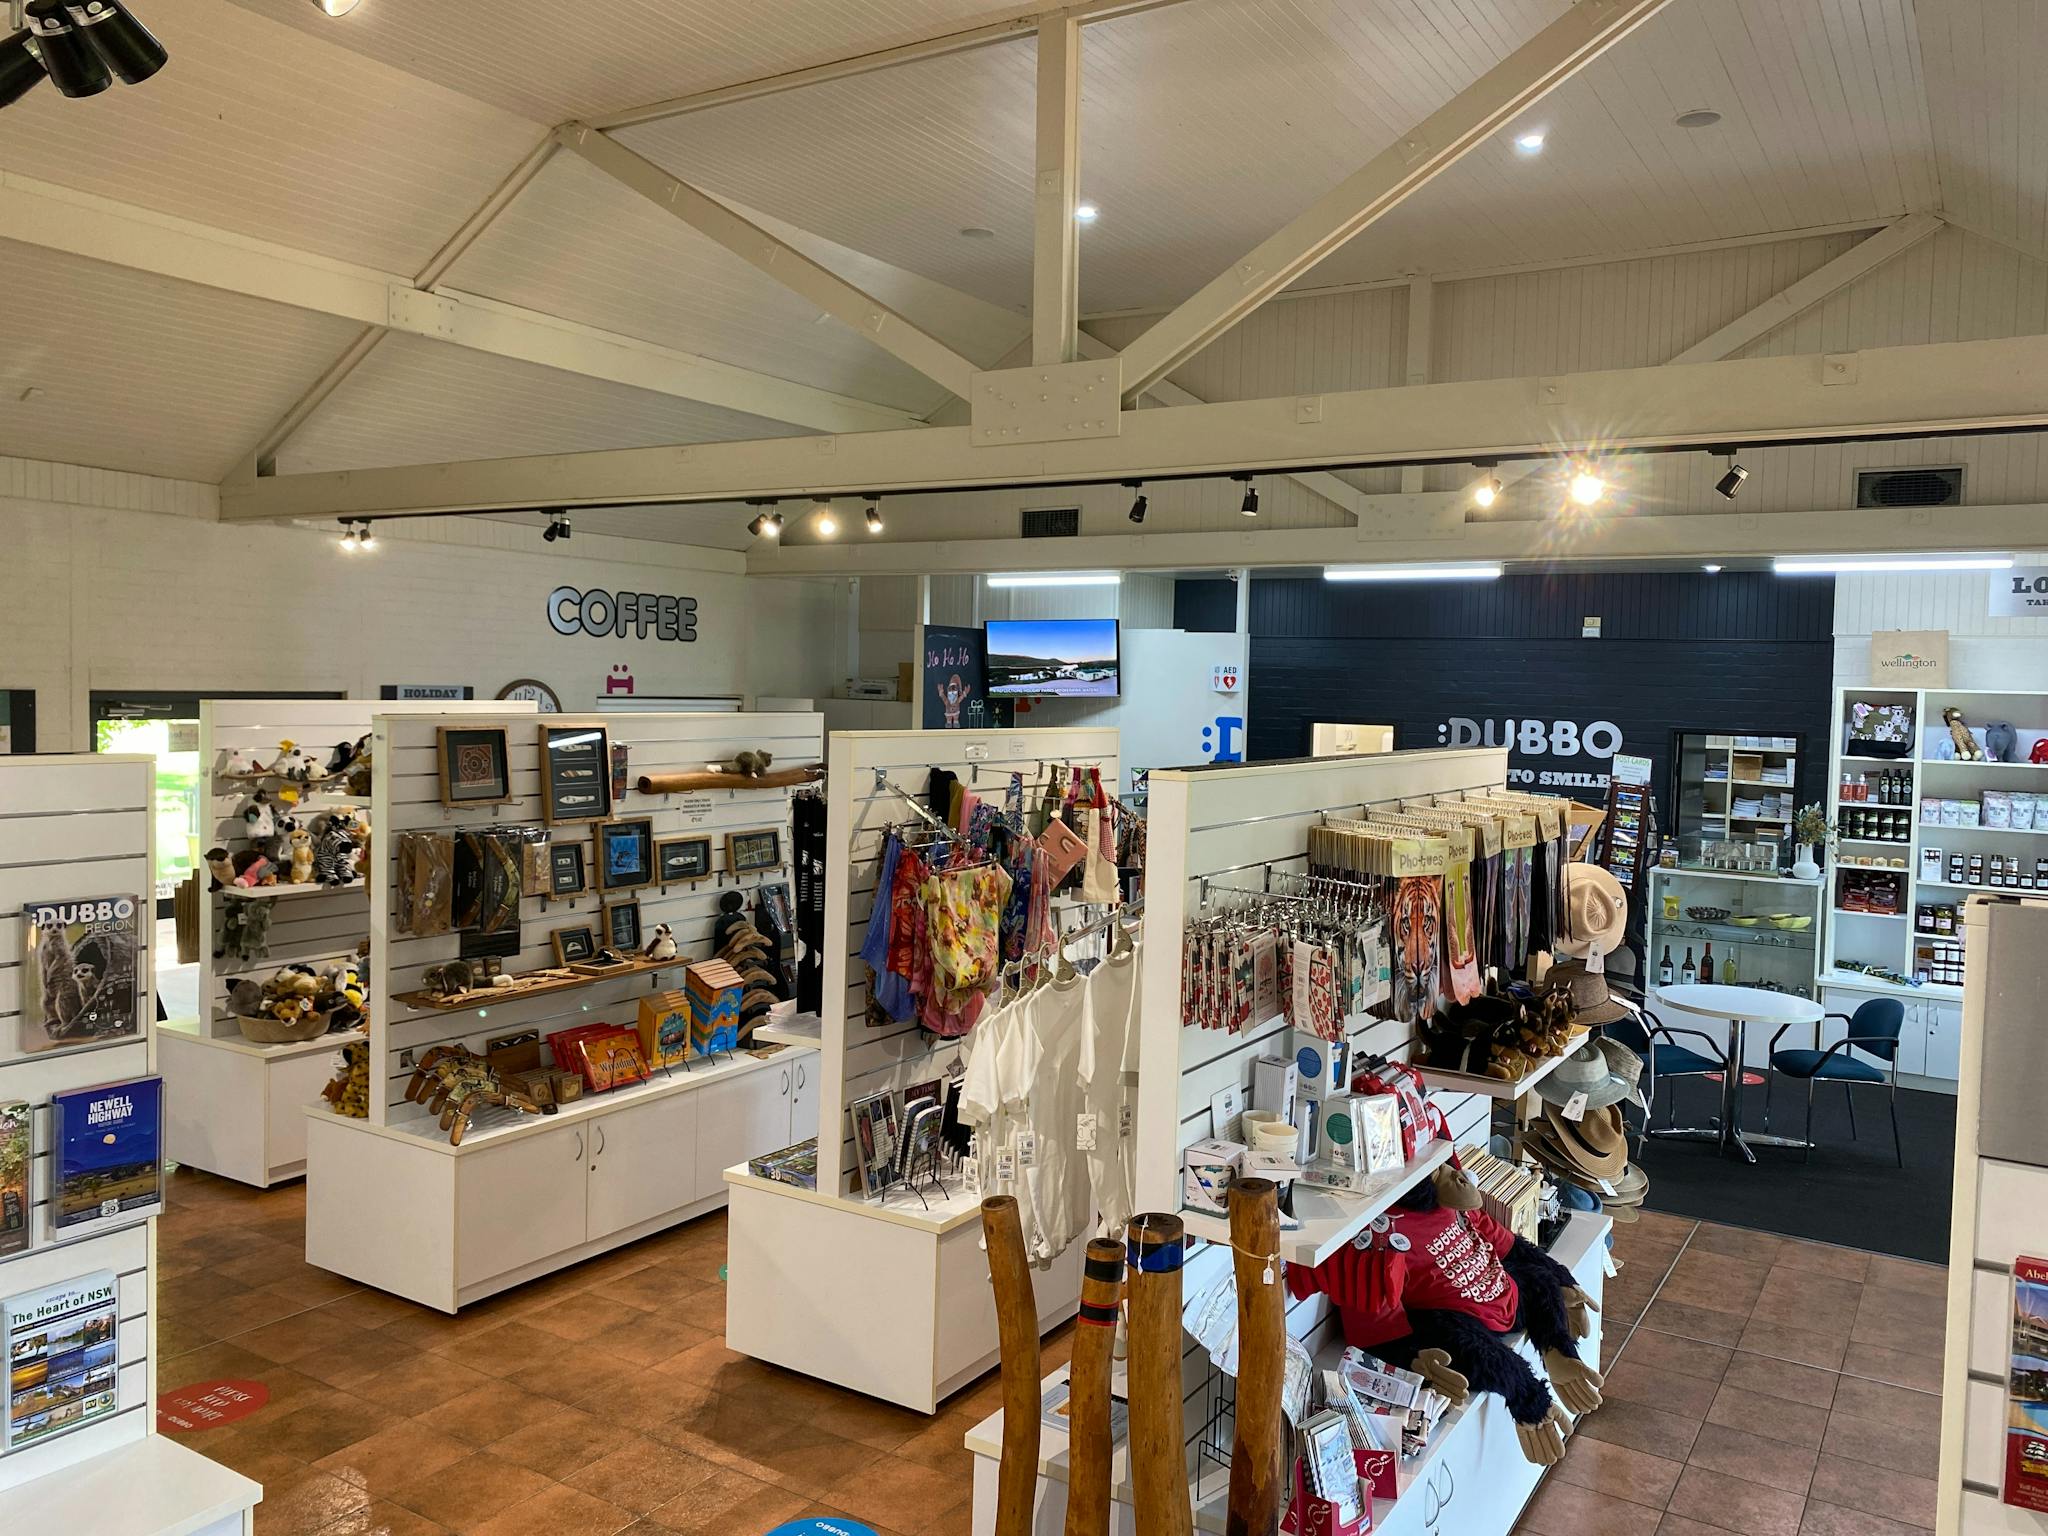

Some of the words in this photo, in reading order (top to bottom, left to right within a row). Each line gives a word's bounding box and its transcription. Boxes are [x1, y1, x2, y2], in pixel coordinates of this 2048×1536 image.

[547, 586, 697, 642] COFFEE
[927, 650, 939, 668] Ho
[943, 647, 955, 668] Ho
[957, 647, 969, 667] Ho
[1881, 657, 1937, 669] wellington
[1223, 666, 1237, 674] AED
[403, 687, 458, 700] HOLIDAY
[1616, 755, 1630, 763] POST
[1632, 758, 1650, 767] CARDS
[1509, 768, 1535, 783] TO
[1539, 772, 1611, 788] SMILE
[84, 919, 134, 934] REGION
[89, 1096, 132, 1113] NEWELL
[87, 1105, 133, 1125] HIGHWAY
[105, 1206, 115, 1214] 39
[12, 1312, 33, 1325] The
[37, 1299, 70, 1318] Heart
[73, 1294, 85, 1306] of
[88, 1286, 113, 1302] NSW
